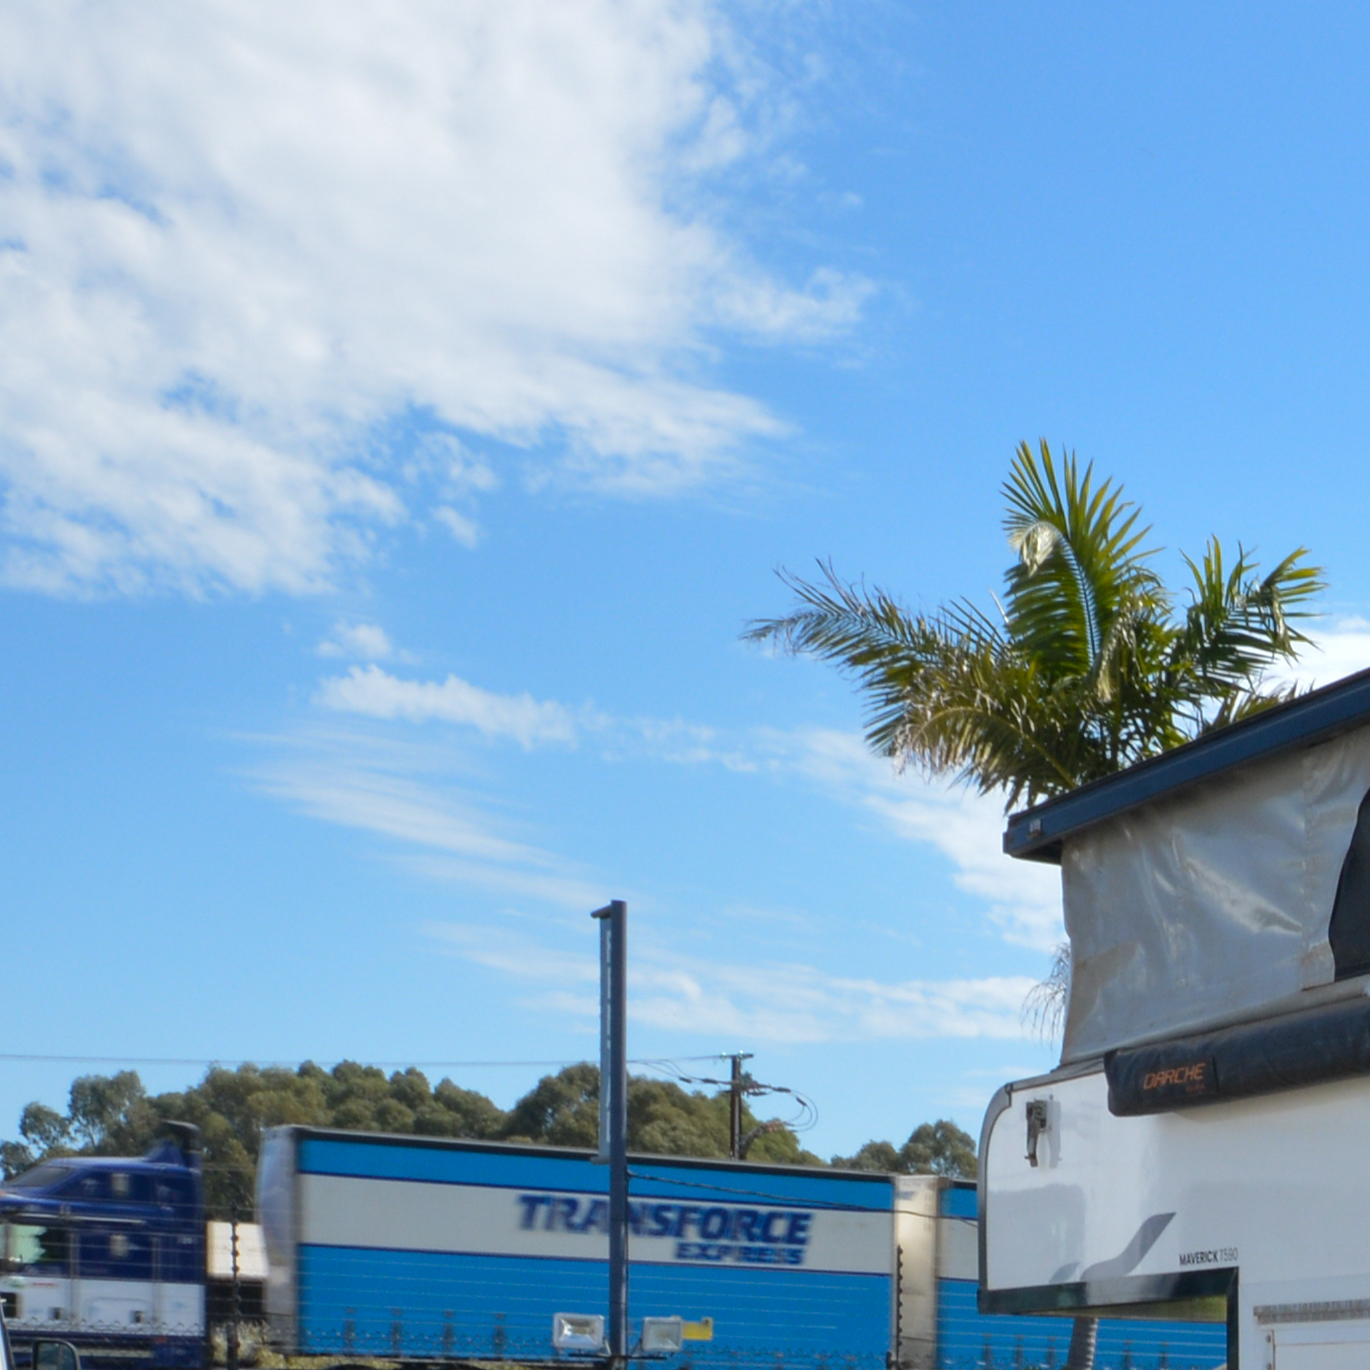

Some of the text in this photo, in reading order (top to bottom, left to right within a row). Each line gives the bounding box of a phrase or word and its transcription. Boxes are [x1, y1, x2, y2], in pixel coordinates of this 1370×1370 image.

[1143, 1063, 1206, 1090] DARCHE
[517, 1194, 814, 1246] TRANSFORCE
[1178, 1250, 1219, 1266] MAVERICK
